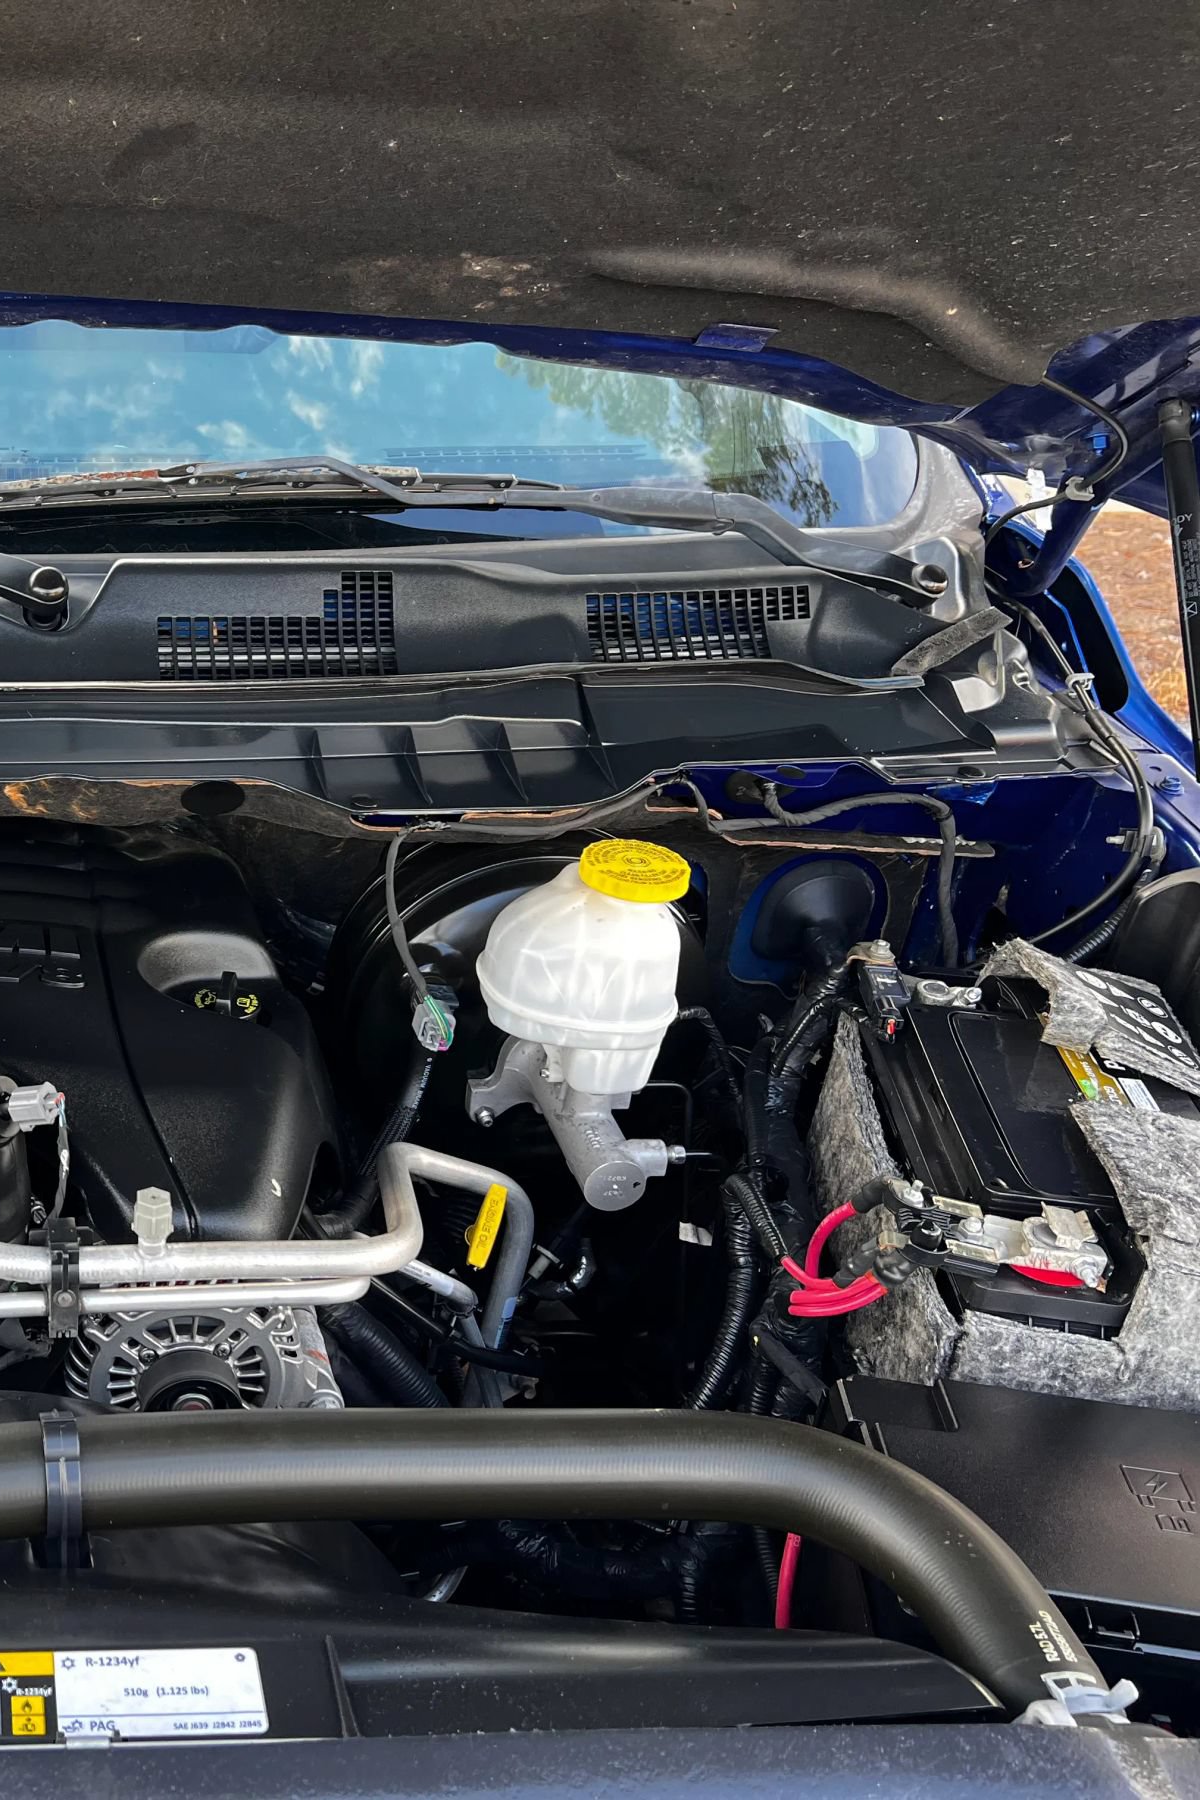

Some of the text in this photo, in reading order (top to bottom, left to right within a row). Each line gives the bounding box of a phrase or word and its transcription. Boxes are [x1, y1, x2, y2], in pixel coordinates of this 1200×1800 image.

[1171, 513, 1193, 526] ODY
[419, 1064, 433, 1089] VACUUM
[475, 1197, 500, 1250] ENGINE OIL
[1039, 1640, 1061, 1663] RAD
[85, 1656, 140, 1668] R-1234yf
[15, 1686, 53, 1697] R-1234yf
[123, 1685, 210, 1698] 510g (1.125 lbs)
[89, 1720, 116, 1732] PAG
[173, 1722, 189, 1730] SAE
[191, 1721, 208, 1730] J639
